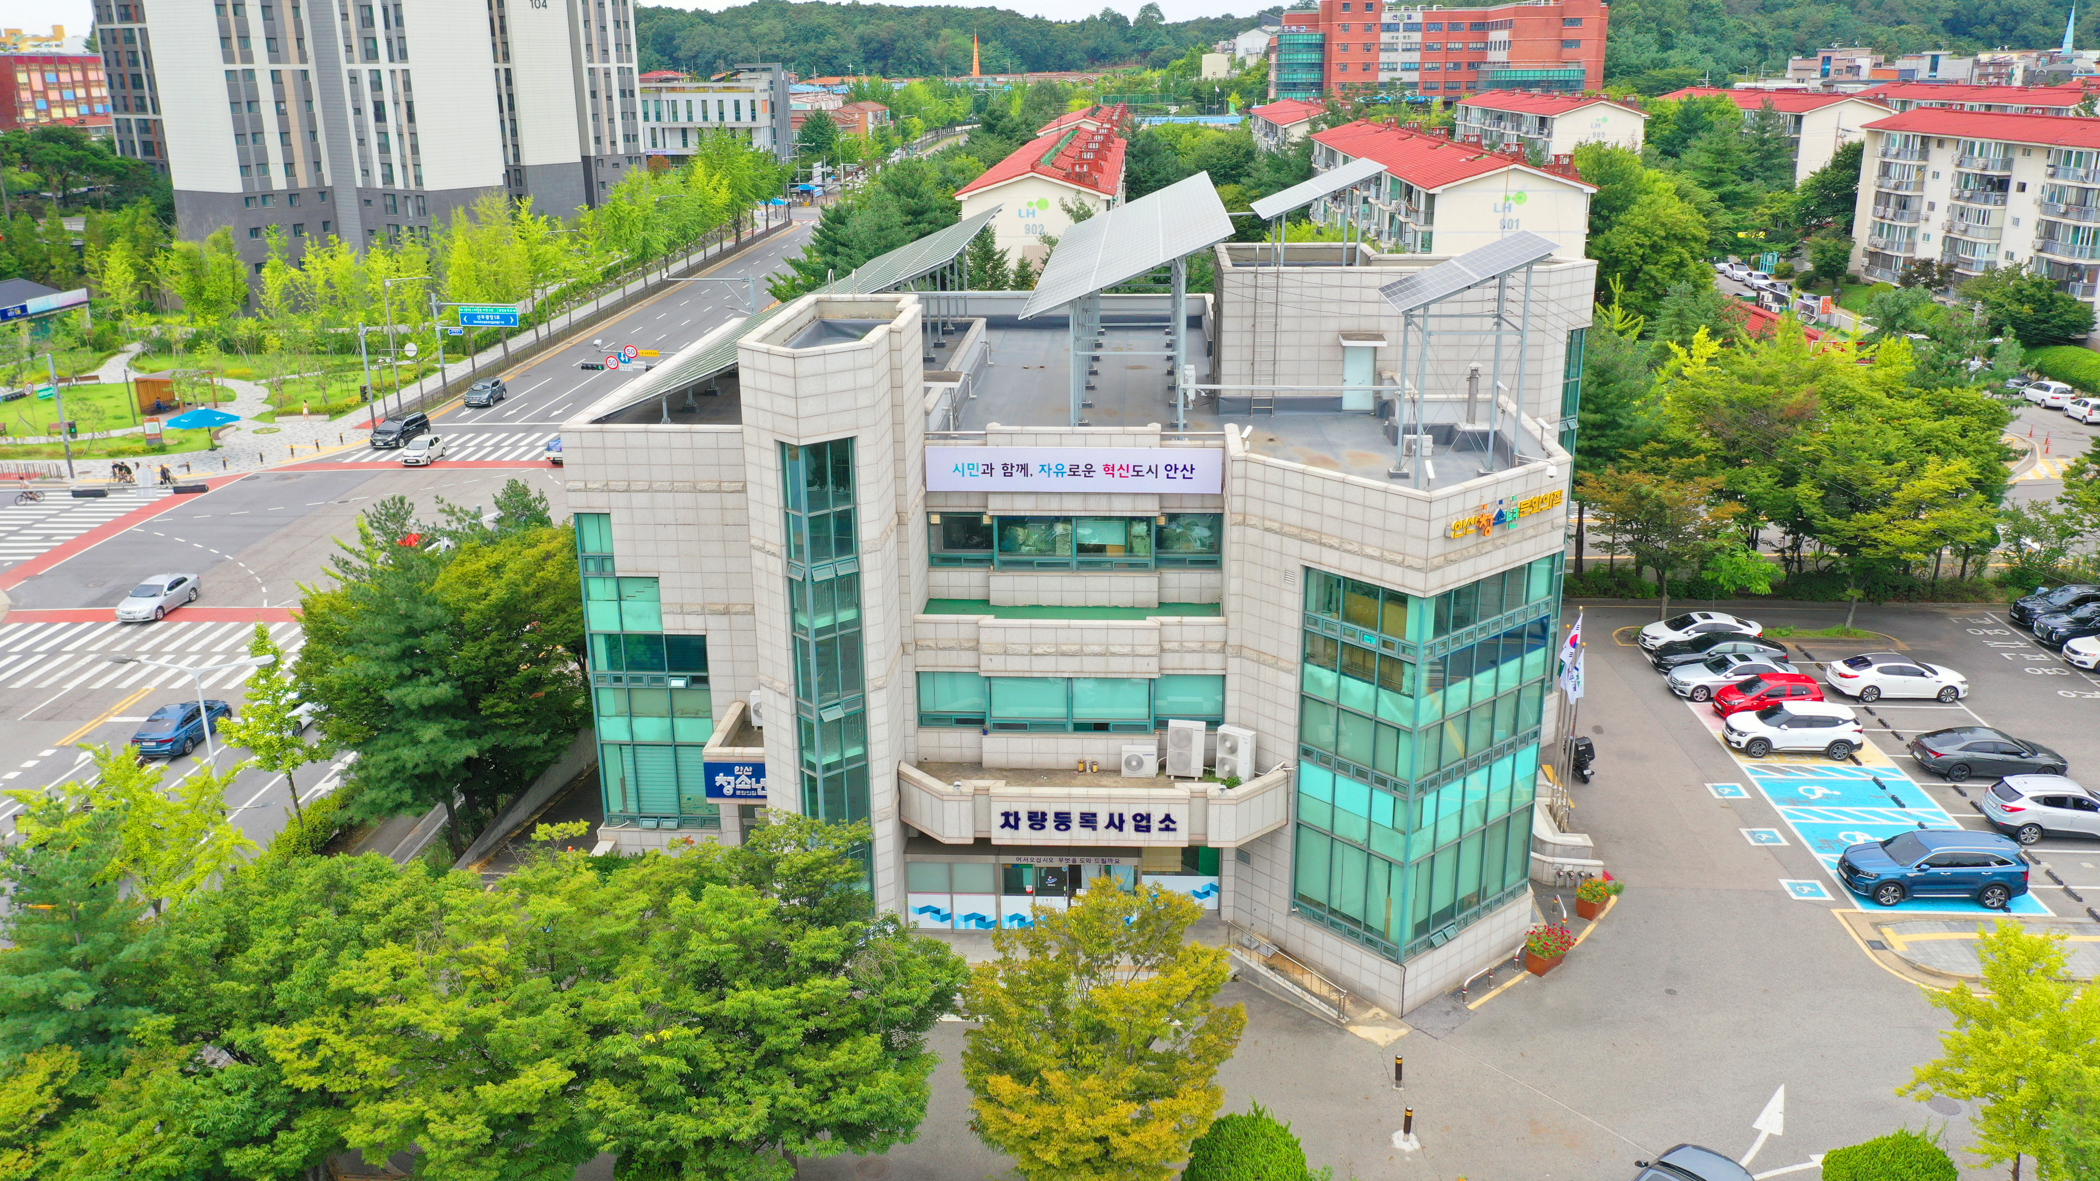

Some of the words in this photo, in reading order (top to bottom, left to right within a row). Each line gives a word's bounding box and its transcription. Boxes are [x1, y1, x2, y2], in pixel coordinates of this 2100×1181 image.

[531, 0, 547, 9] 104
[1018, 208, 1036, 218] LH
[1493, 202, 1512, 213] LH
[1024, 223, 1045, 235] 902
[1500, 218, 1520, 230] 901
[952, 462, 995, 478] 시민과
[1001, 462, 1033, 478] 함께,
[1038, 462, 1097, 478] 자유로운
[1102, 463, 1159, 479] 혁신도시
[1164, 463, 1196, 480] 안산
[734, 765, 753, 775] 안산
[999, 810, 1178, 833] 차량등록사업소
